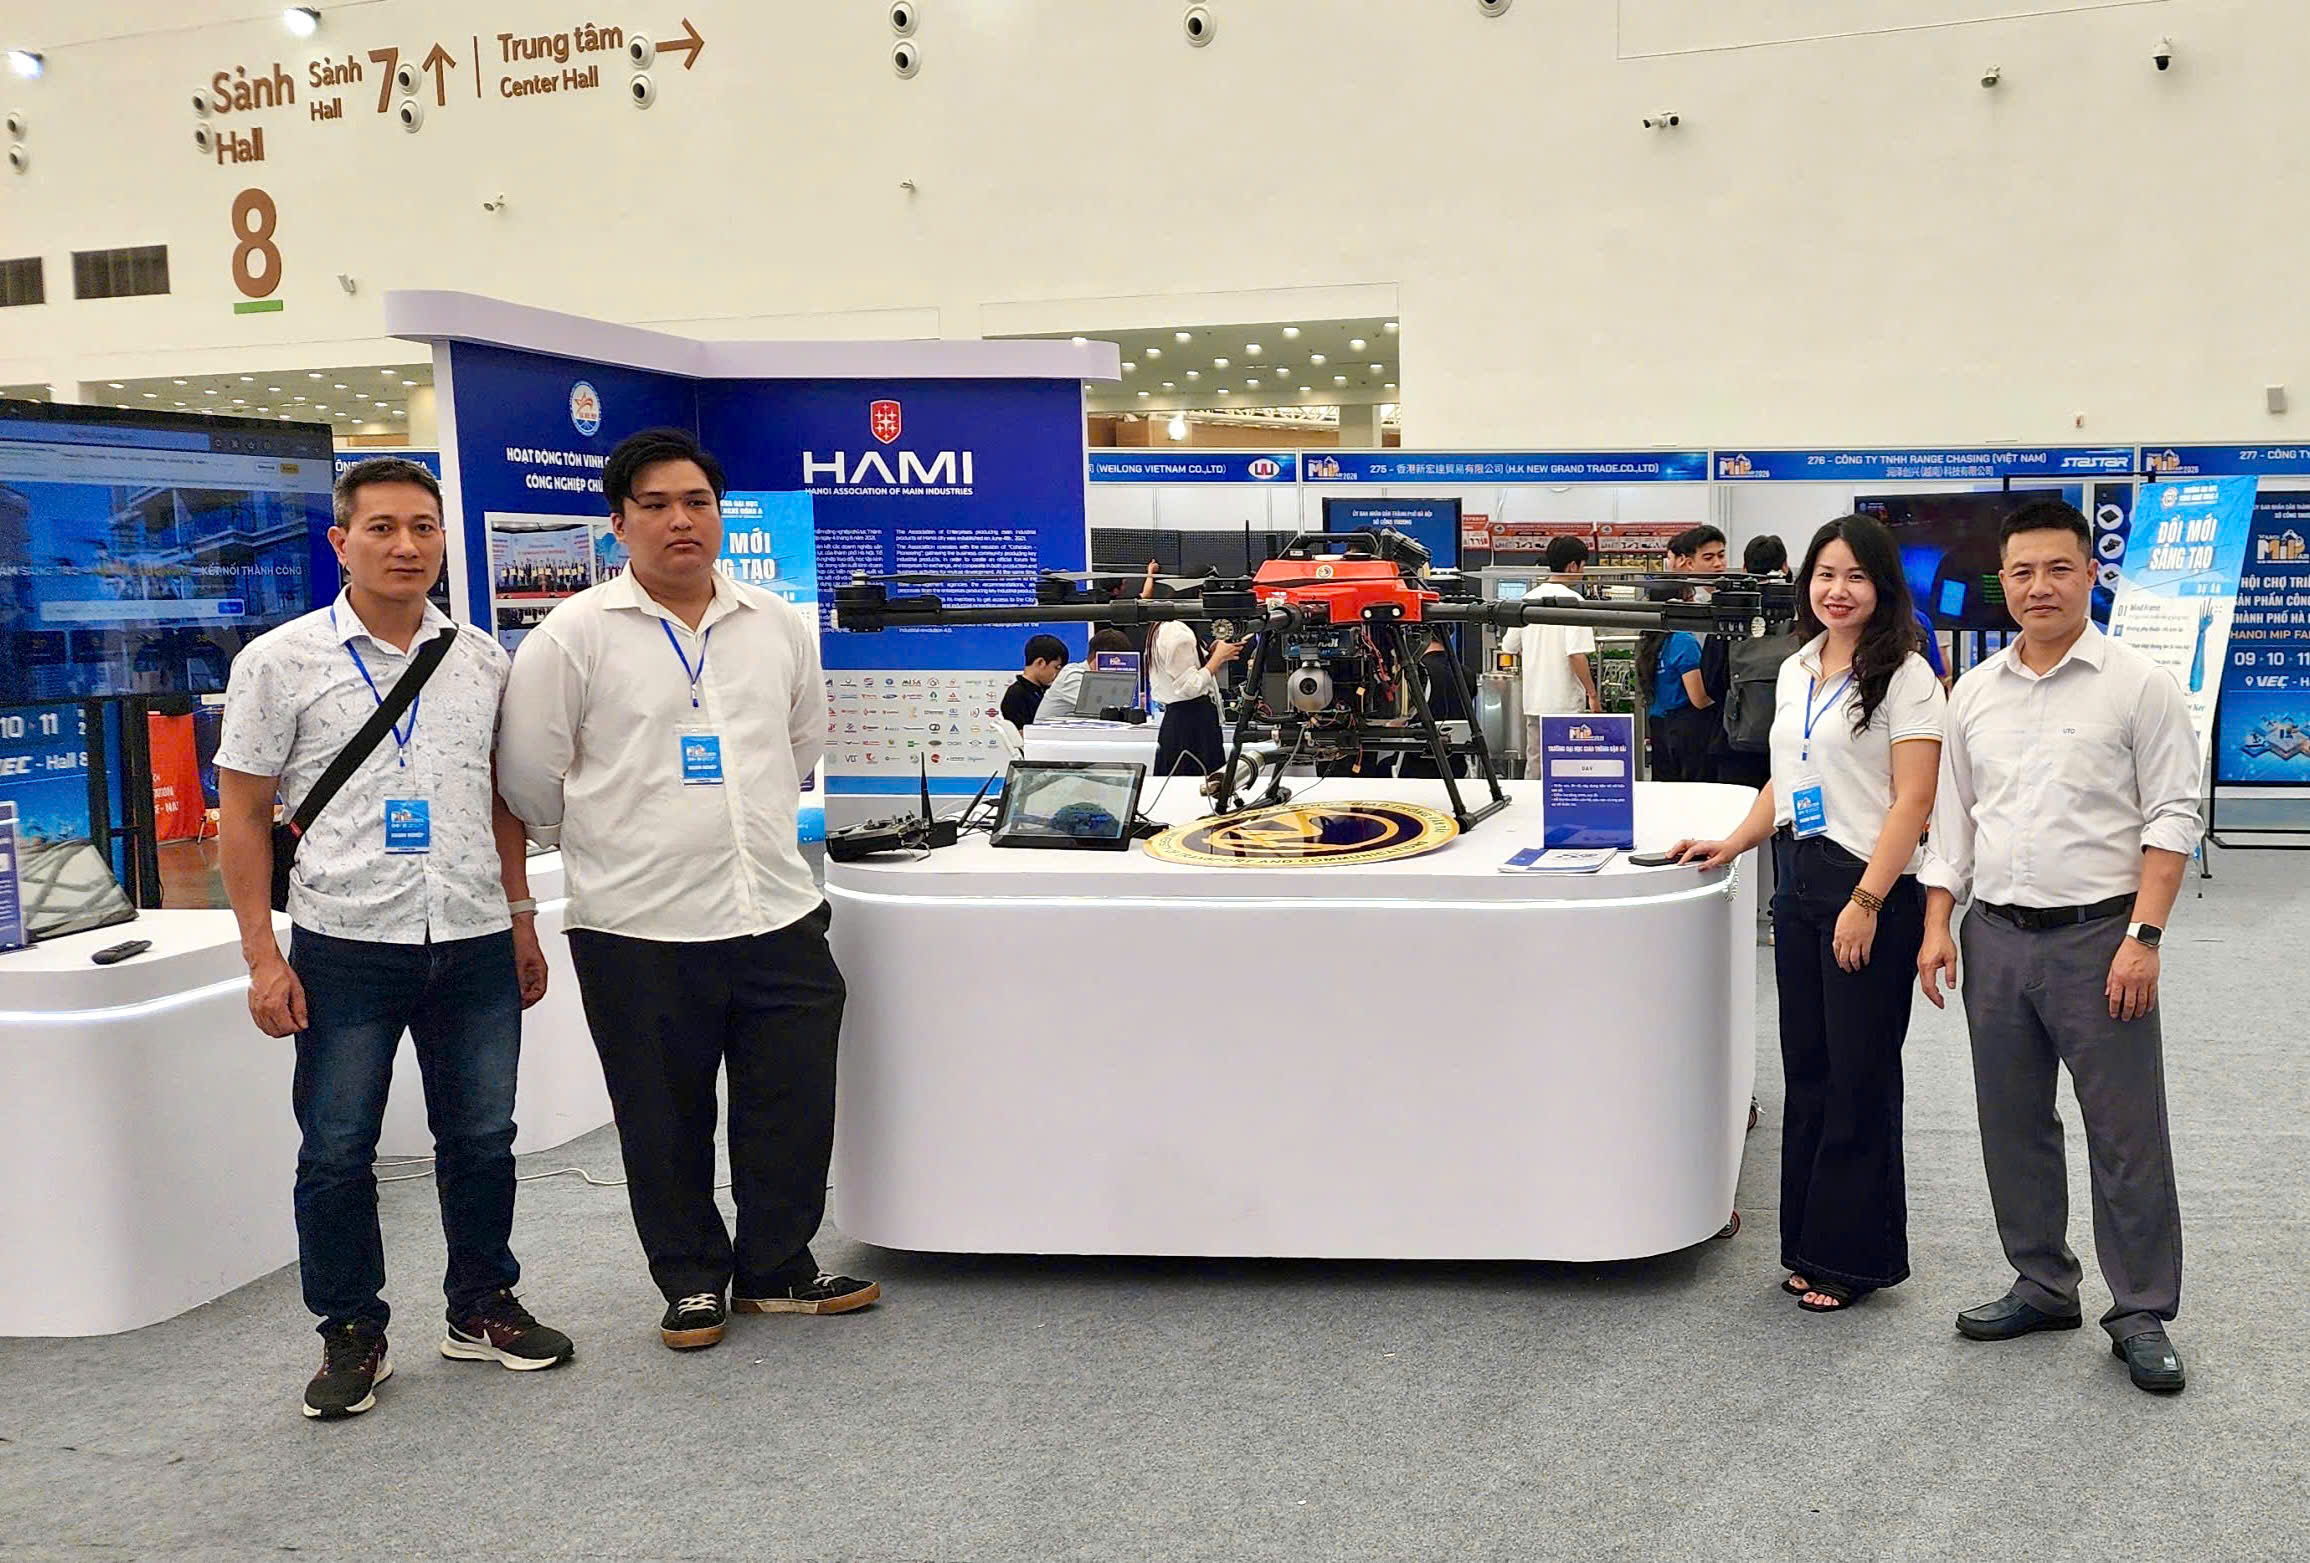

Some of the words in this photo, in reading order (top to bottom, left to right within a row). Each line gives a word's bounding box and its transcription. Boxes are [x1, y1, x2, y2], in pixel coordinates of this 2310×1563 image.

[497, 33, 569, 63] Trung
[574, 22, 623, 53] tâm
[212, 62, 295, 114] Sảnh
[309, 55, 362, 88] Sảnh
[367, 47, 398, 113] 7
[500, 75, 559, 98] Center
[562, 65, 599, 91] Hall
[310, 97, 343, 121] Hall
[215, 127, 265, 165] Hall
[232, 188, 281, 298] 8
[506, 447, 534, 464] HOẠT
[535, 448, 563, 467] ĐỘNG
[564, 451, 583, 467] TÔN
[583, 454, 605, 469] VINH
[1807, 456, 1825, 465] 276
[1835, 454, 1863, 464] CÔNG
[1865, 455, 1878, 464] TY
[1880, 455, 1907, 464] TNHH
[1910, 455, 1944, 464] RANGE
[1946, 454, 1990, 463] CHASING
[1992, 452, 2019, 464] (VIỆT
[2020, 453, 2047, 463] NAM)
[2240, 451, 2258, 460] 277
[2267, 448, 2297, 459] CÔNG
[335, 459, 360, 472] ÔN
[802, 451, 973, 484] HAMI
[1096, 464, 1142, 474] (WEILONG
[1145, 464, 1186, 474] VIETNAM
[1369, 464, 1387, 474] 275
[1527, 464, 1548, 474] NEW
[1551, 464, 1584, 474] GRAND
[526, 472, 553, 489] CÔNG
[554, 476, 587, 493] NGHIỆP
[805, 487, 832, 496] HANOI
[833, 487, 888, 496] ASSOCIATION
[889, 487, 901, 496] OF
[902, 487, 923, 496] MAIN
[925, 487, 973, 496] INDUSTRIES
[2157, 514, 2183, 544] ĐỔI
[2186, 512, 2218, 542] MỚI
[729, 527, 772, 554] MỚI
[222, 562, 240, 576] NỐI
[241, 562, 274, 576] THÀNH
[2150, 544, 2185, 571] SÁNG
[2188, 546, 2214, 574] TẠO
[740, 559, 776, 585] TẠO
[2241, 574, 2260, 591] HỘI
[2263, 576, 2287, 591] CHỢ
[2266, 609, 2288, 624] PHỐ
[2291, 610, 2305, 624] HÀ
[2230, 630, 2266, 640] HANOI
[2270, 630, 2291, 640] MIP
[2234, 652, 2256, 666] 09
[2266, 652, 2285, 666] 10
[2297, 652, 2310, 666] 11
[0, 715, 24, 739] 10
[39, 712, 59, 735] 11
[46, 752, 78, 771] Hall
[1299, 841, 1428, 863] COMMUNICATIONS
